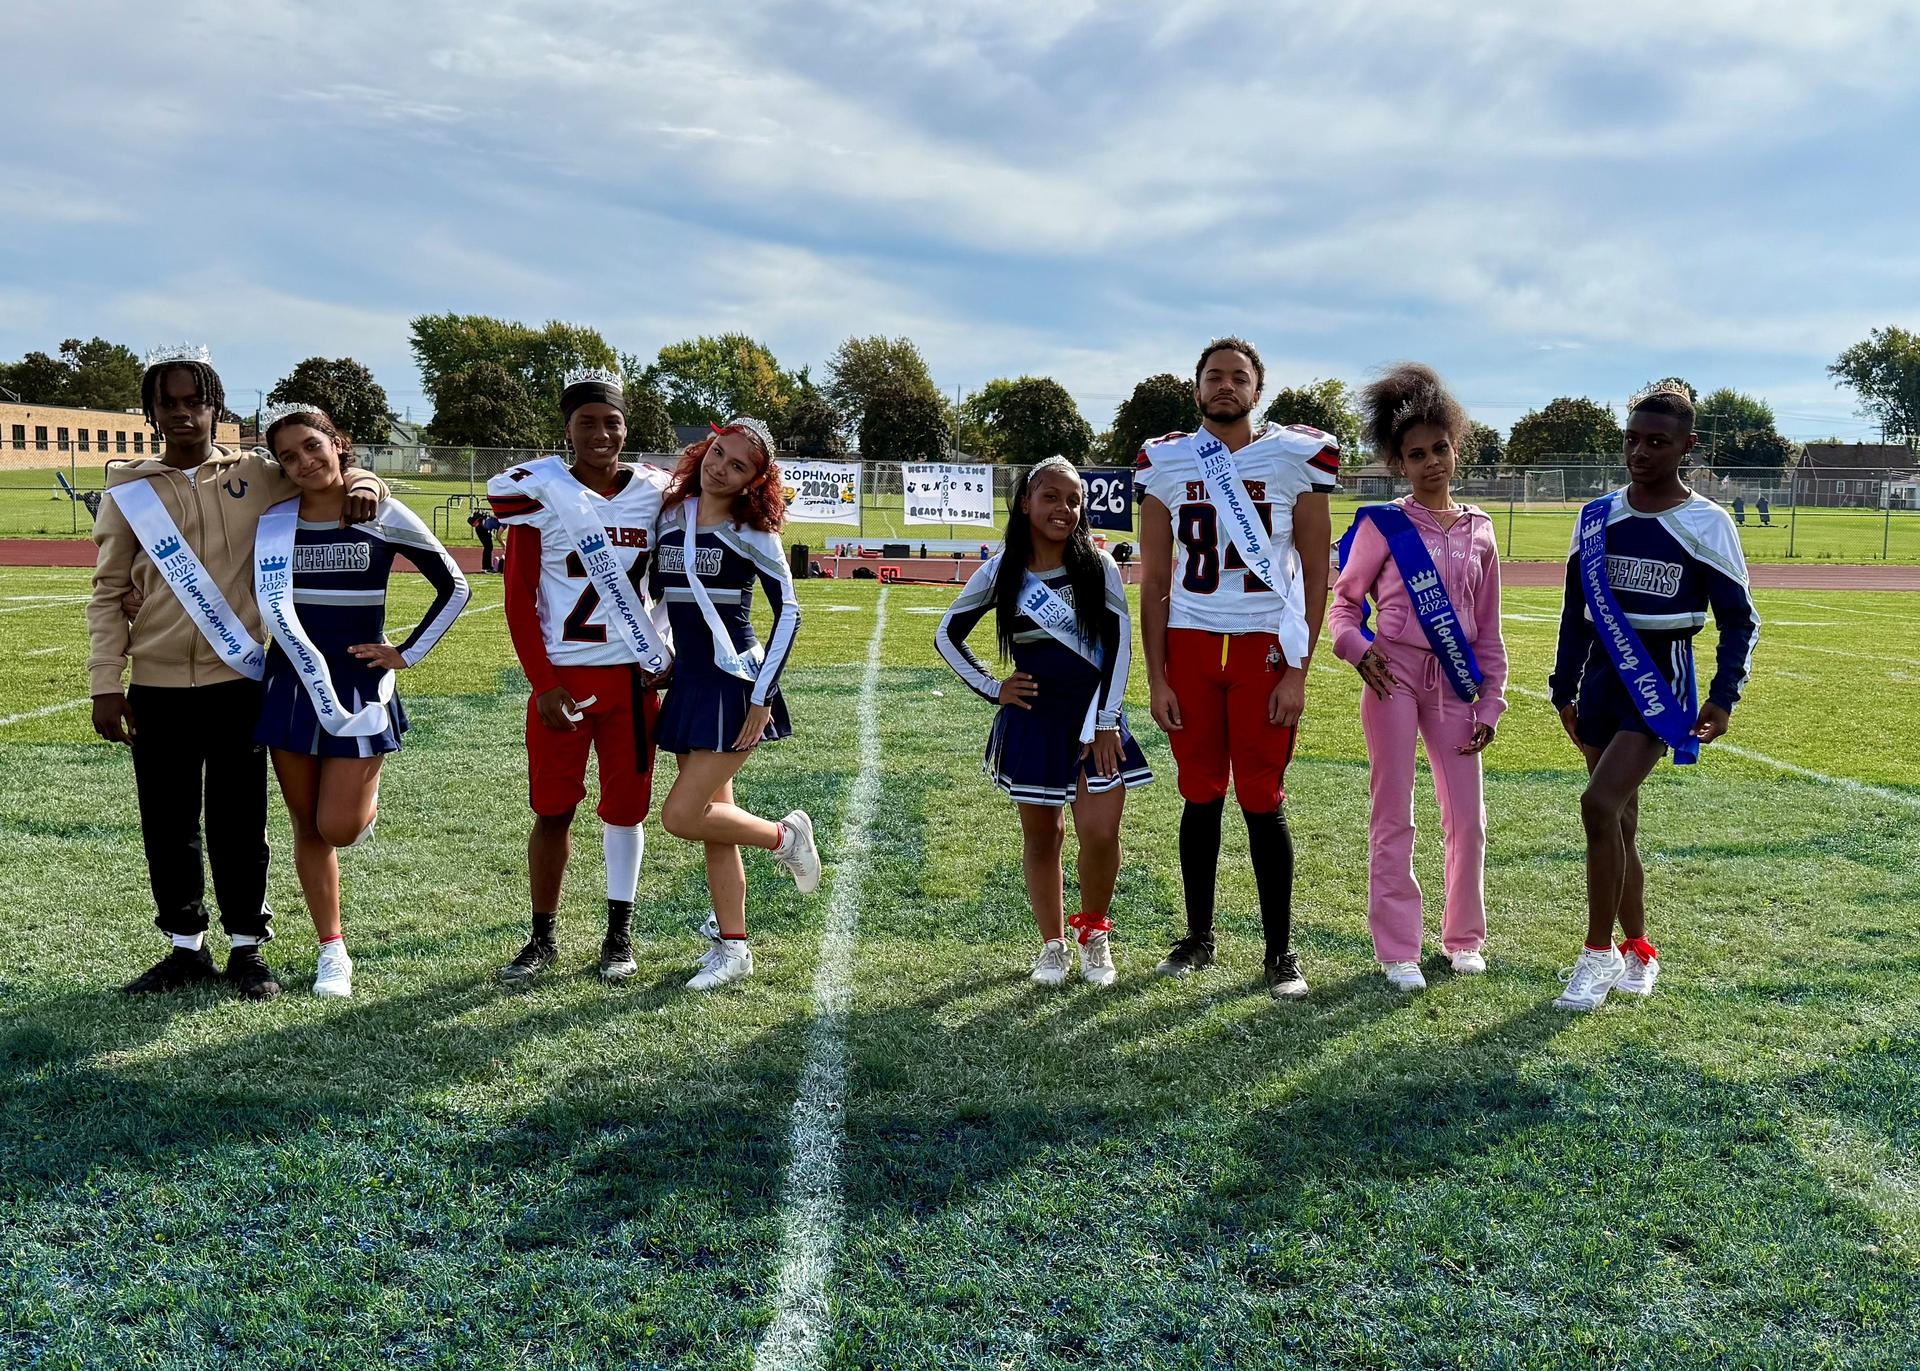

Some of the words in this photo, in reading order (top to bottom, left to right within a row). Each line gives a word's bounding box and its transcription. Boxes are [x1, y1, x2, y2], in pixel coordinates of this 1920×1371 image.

[908, 465, 934, 474] NEXT
[939, 465, 952, 474] IN
[1205, 454, 1226, 469] LHS
[784, 470, 855, 484] SOPHMORE
[1205, 462, 1231, 479] 2025
[802, 481, 839, 499] 2028
[910, 506, 943, 518] READY
[961, 509, 991, 520] SHINE
[1215, 471, 1261, 555] Homecoming
[1584, 533, 1603, 549] LHS
[587, 550, 610, 567] LHS
[1581, 543, 1604, 560] 2025
[164, 552, 188, 571] LHS
[589, 560, 617, 577] 2025
[167, 560, 196, 582] 2025
[262, 571, 285, 583] LHS
[259, 580, 288, 593] 2025
[1417, 588, 1442, 604] LHS
[180, 572, 242, 656] Homecoming
[602, 572, 650, 654] Homecoming
[1038, 600, 1058, 620] LHS
[1418, 597, 1449, 616] 2025
[1043, 607, 1067, 629] 2025
[1586, 556, 1639, 670] Homecoming
[1634, 671, 1665, 717] King
[268, 590, 316, 676] Homecoming
[312, 680, 332, 717] Lady
